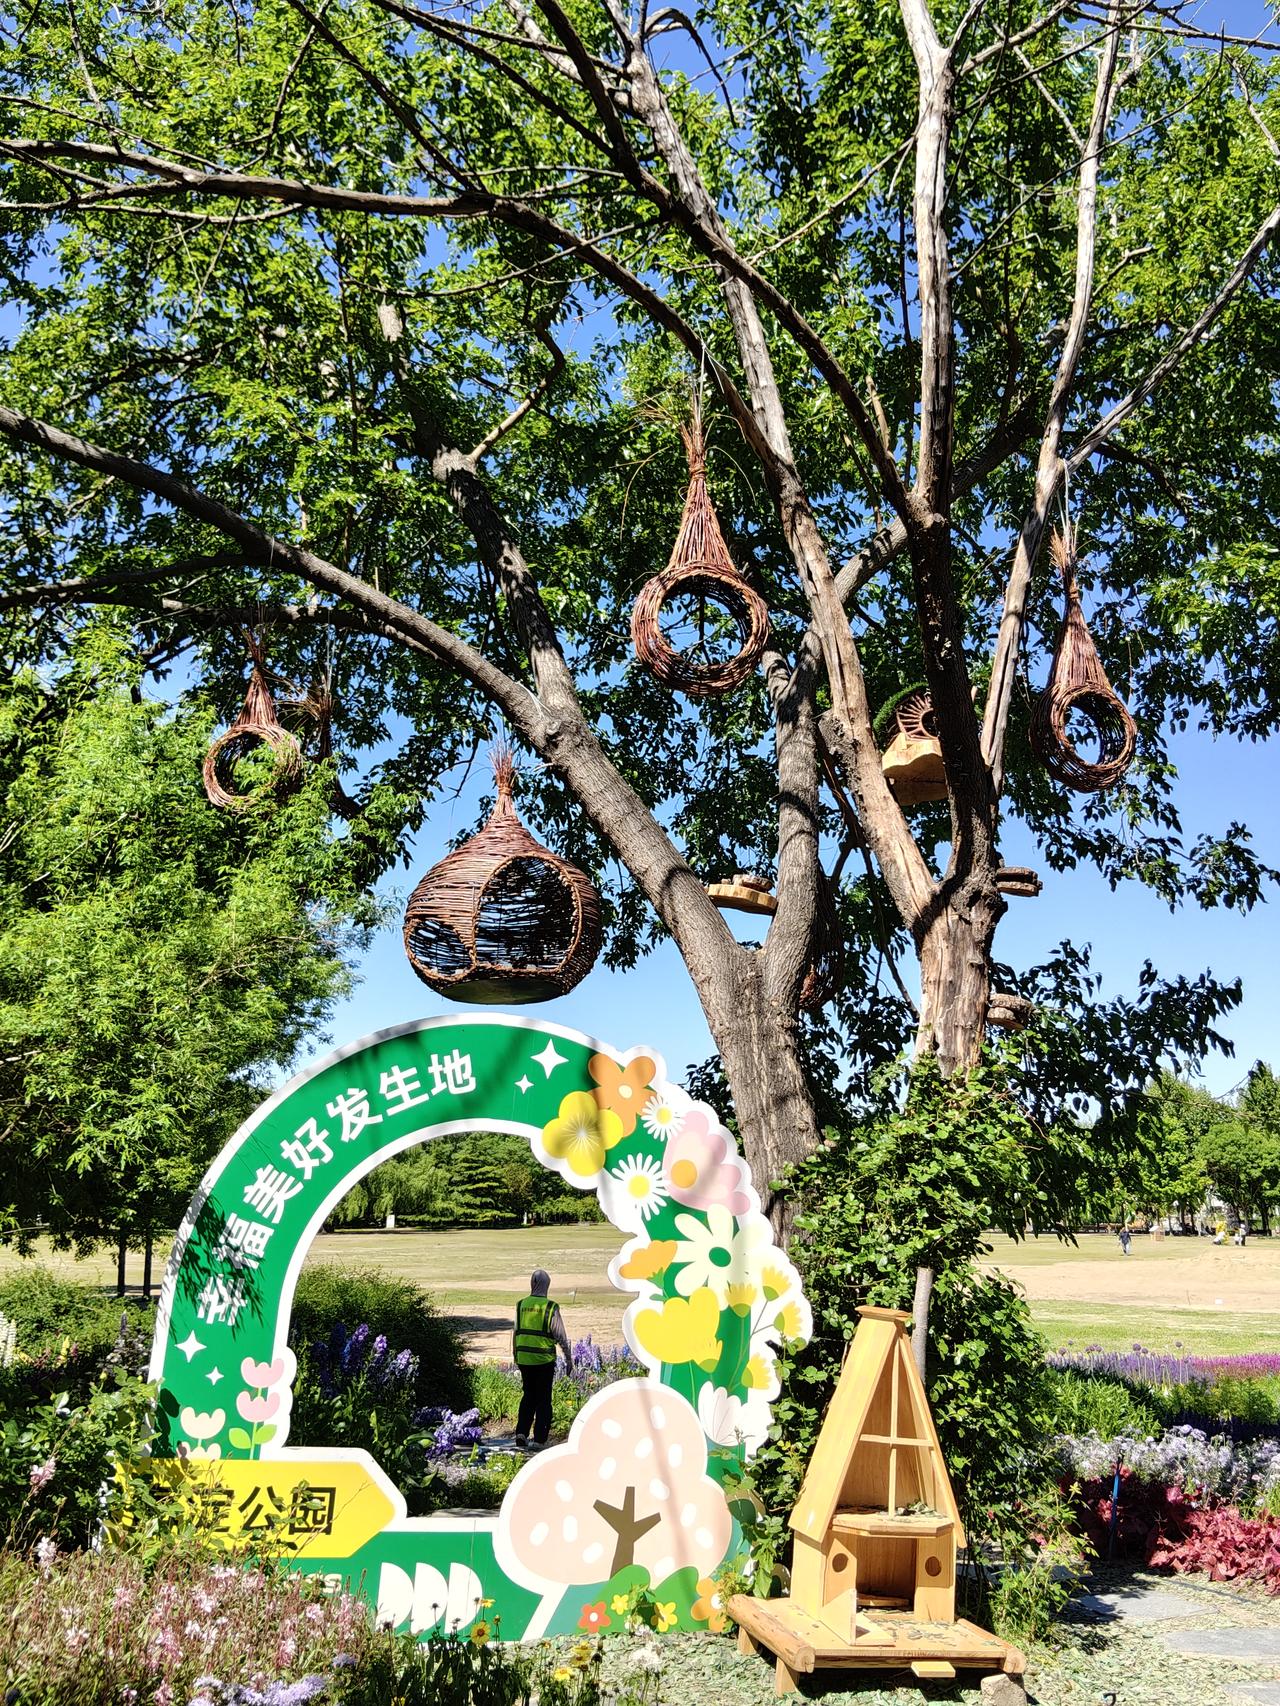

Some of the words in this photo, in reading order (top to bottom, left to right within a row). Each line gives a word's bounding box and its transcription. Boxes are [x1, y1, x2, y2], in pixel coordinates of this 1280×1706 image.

[197, 1048, 476, 1326] 幸福美好发生地
